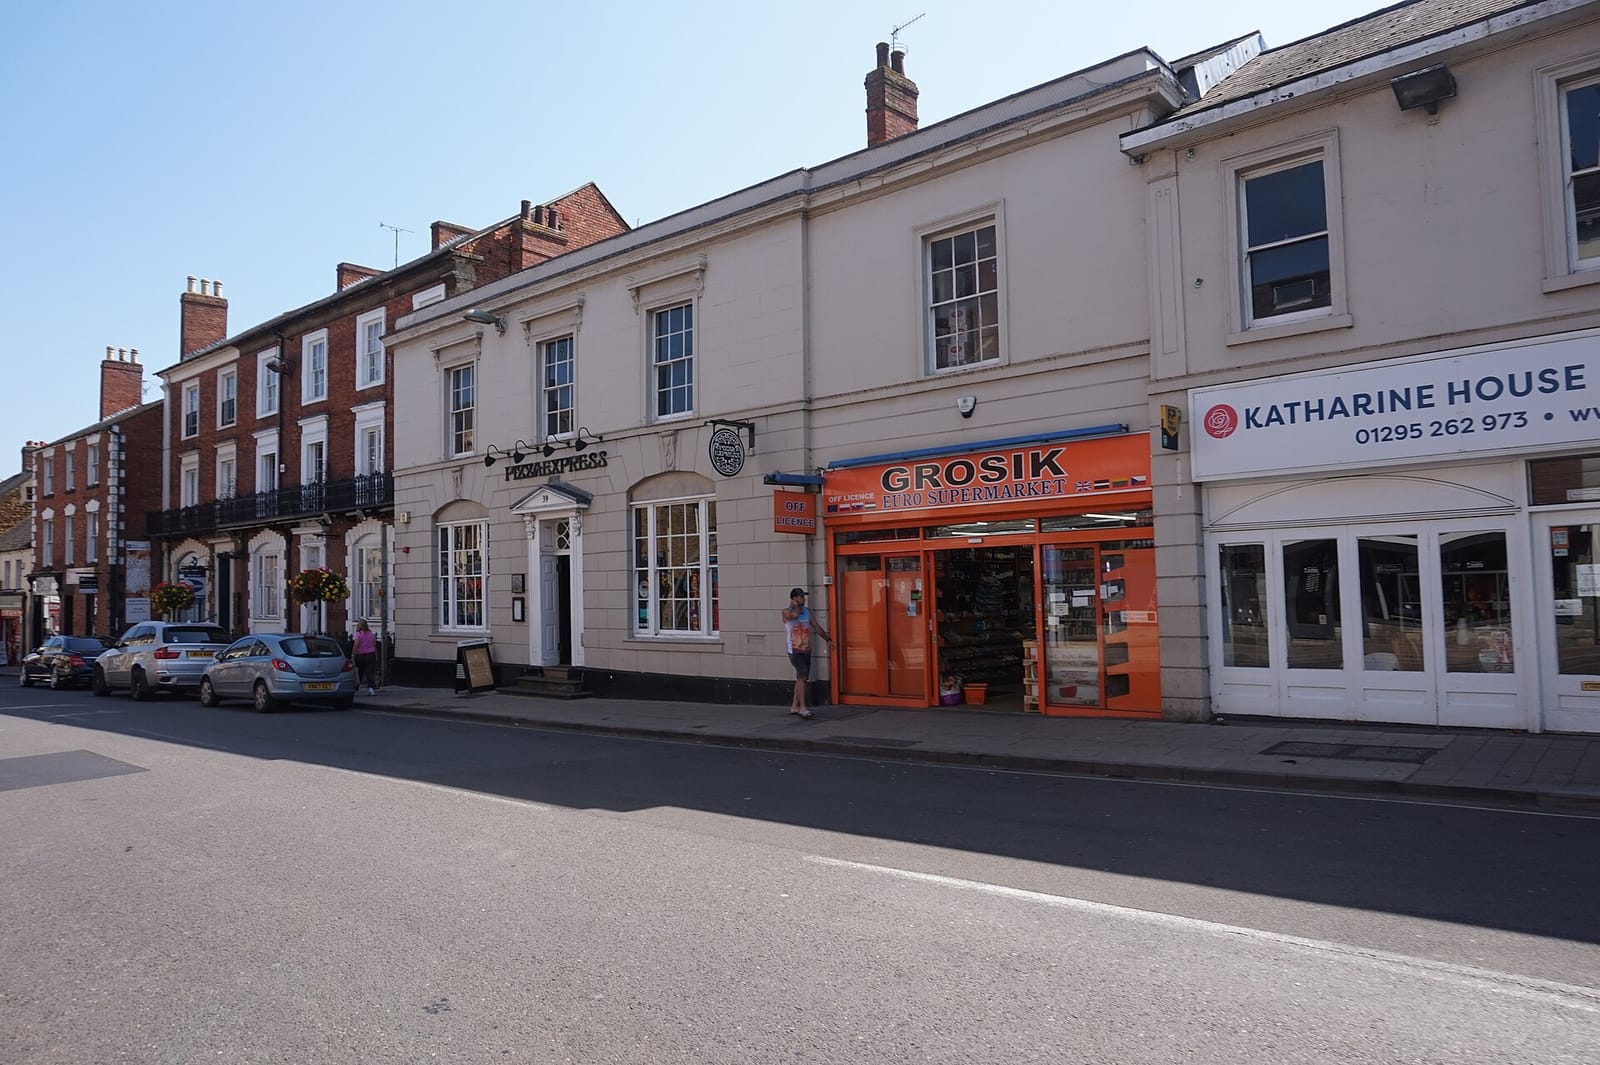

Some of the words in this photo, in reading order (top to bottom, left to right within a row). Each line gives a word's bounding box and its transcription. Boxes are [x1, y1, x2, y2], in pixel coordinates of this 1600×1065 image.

[1245, 384, 1435, 429] KATHARINE
[1447, 364, 1586, 405] HOUSE
[1355, 423, 1423, 445] 01295
[1430, 417, 1475, 437] 262
[1482, 411, 1528, 431] 973
[881, 447, 1068, 493] GROSIK
[785, 501, 807, 512] OFF
[844, 492, 875, 501] LICENCE
[882, 492, 922, 509] EURO
[927, 478, 1067, 505] SUPERMARKET
[776, 516, 815, 528] LICENCE
